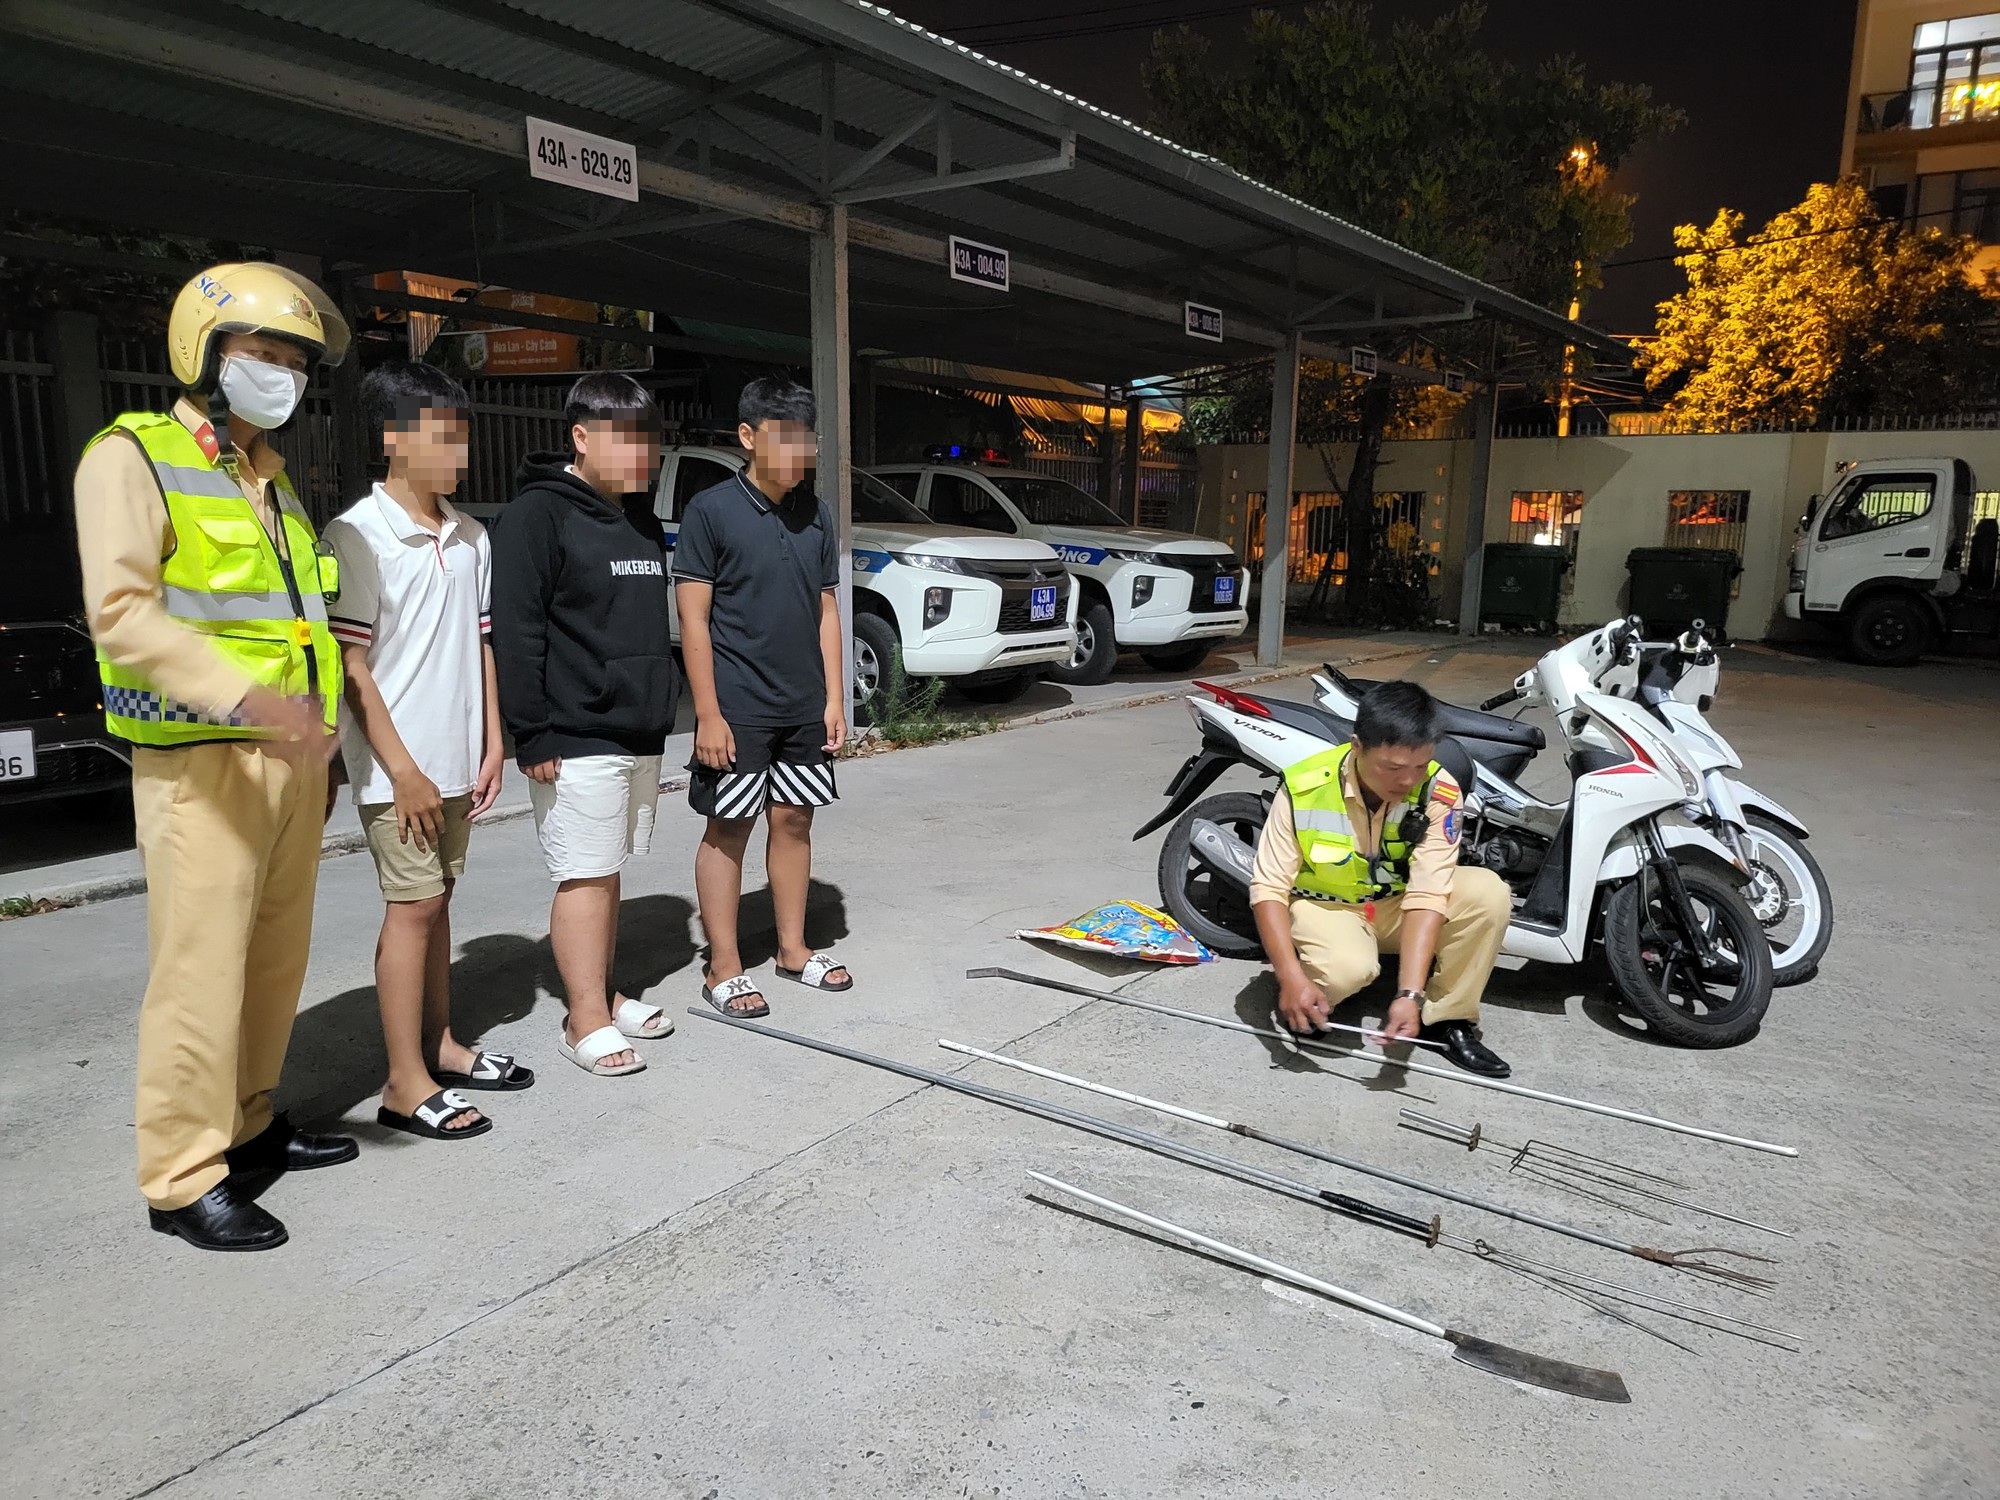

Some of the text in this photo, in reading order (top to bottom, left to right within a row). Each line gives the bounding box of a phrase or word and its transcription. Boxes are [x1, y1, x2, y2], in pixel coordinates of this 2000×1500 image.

[537, 136, 568, 169] 43A
[581, 147, 632, 185] 629.29
[955, 248, 971, 271] 43A
[977, 254, 1005, 279] 004.99
[190, 272, 238, 308] SGT
[610, 560, 663, 576] MIKEBEAR
[1037, 589, 1050, 604] 43A
[1233, 717, 1287, 741] VISION
[1588, 784, 1624, 798] HONDA
